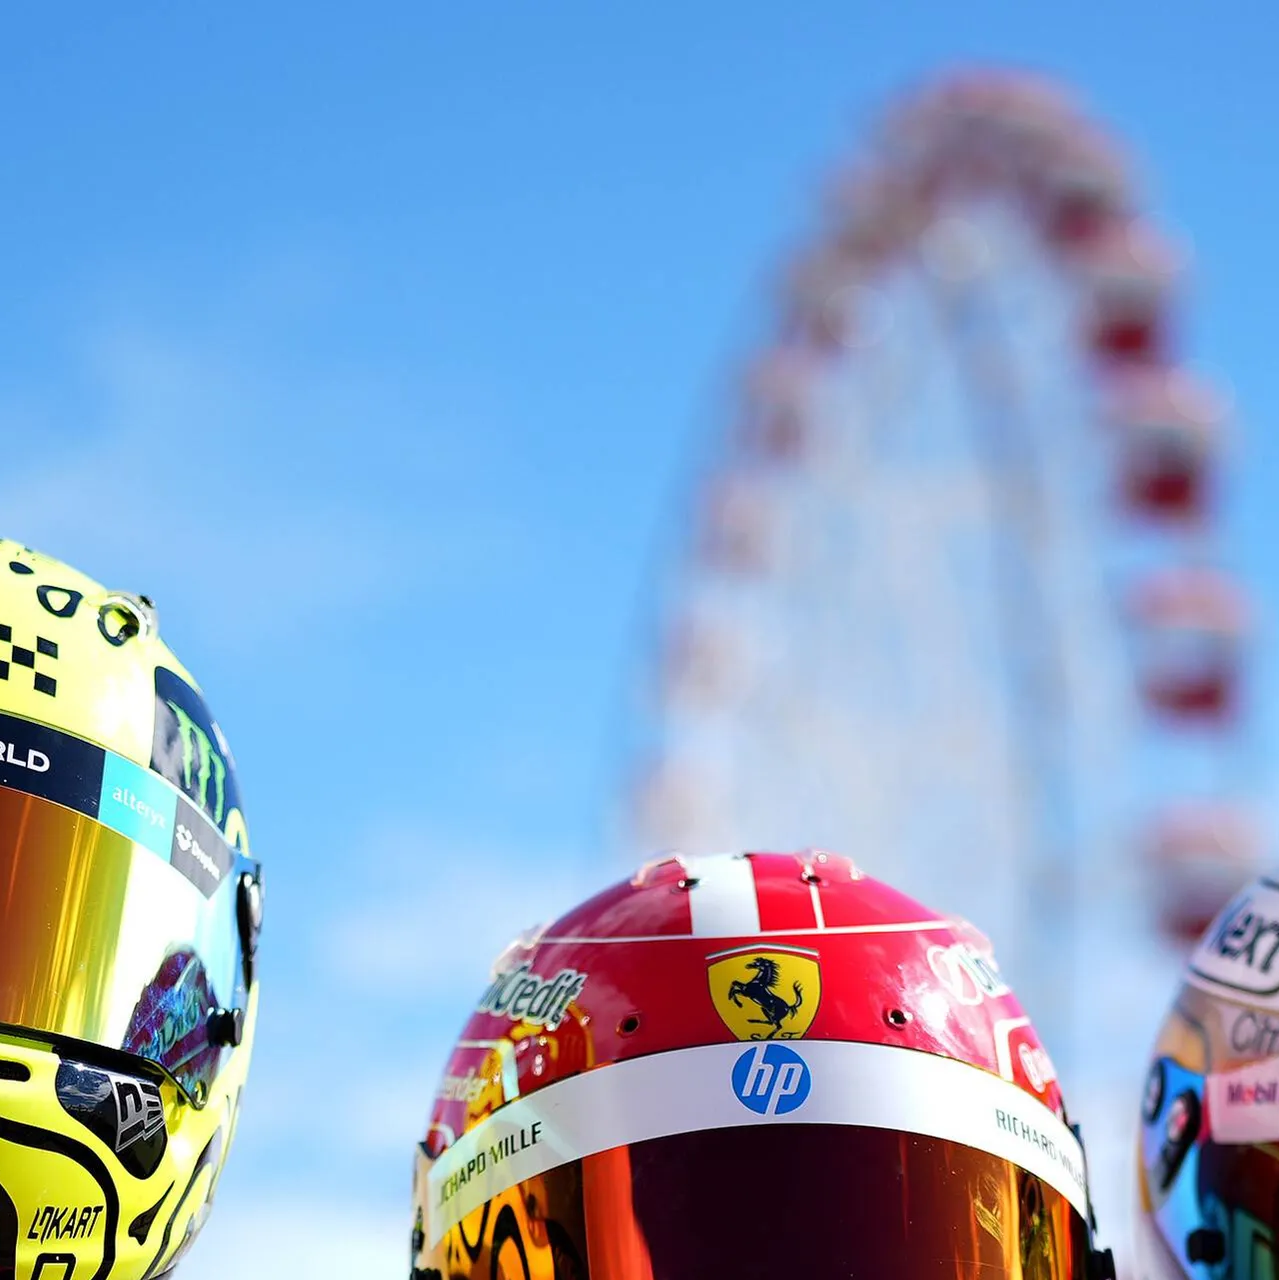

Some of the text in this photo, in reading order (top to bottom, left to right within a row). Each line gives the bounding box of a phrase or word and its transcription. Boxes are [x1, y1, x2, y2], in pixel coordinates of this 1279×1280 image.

[112, 786, 167, 829] alteryx
[741, 1043, 804, 1116] hp
[995, 1107, 1057, 1161] RICHARD
